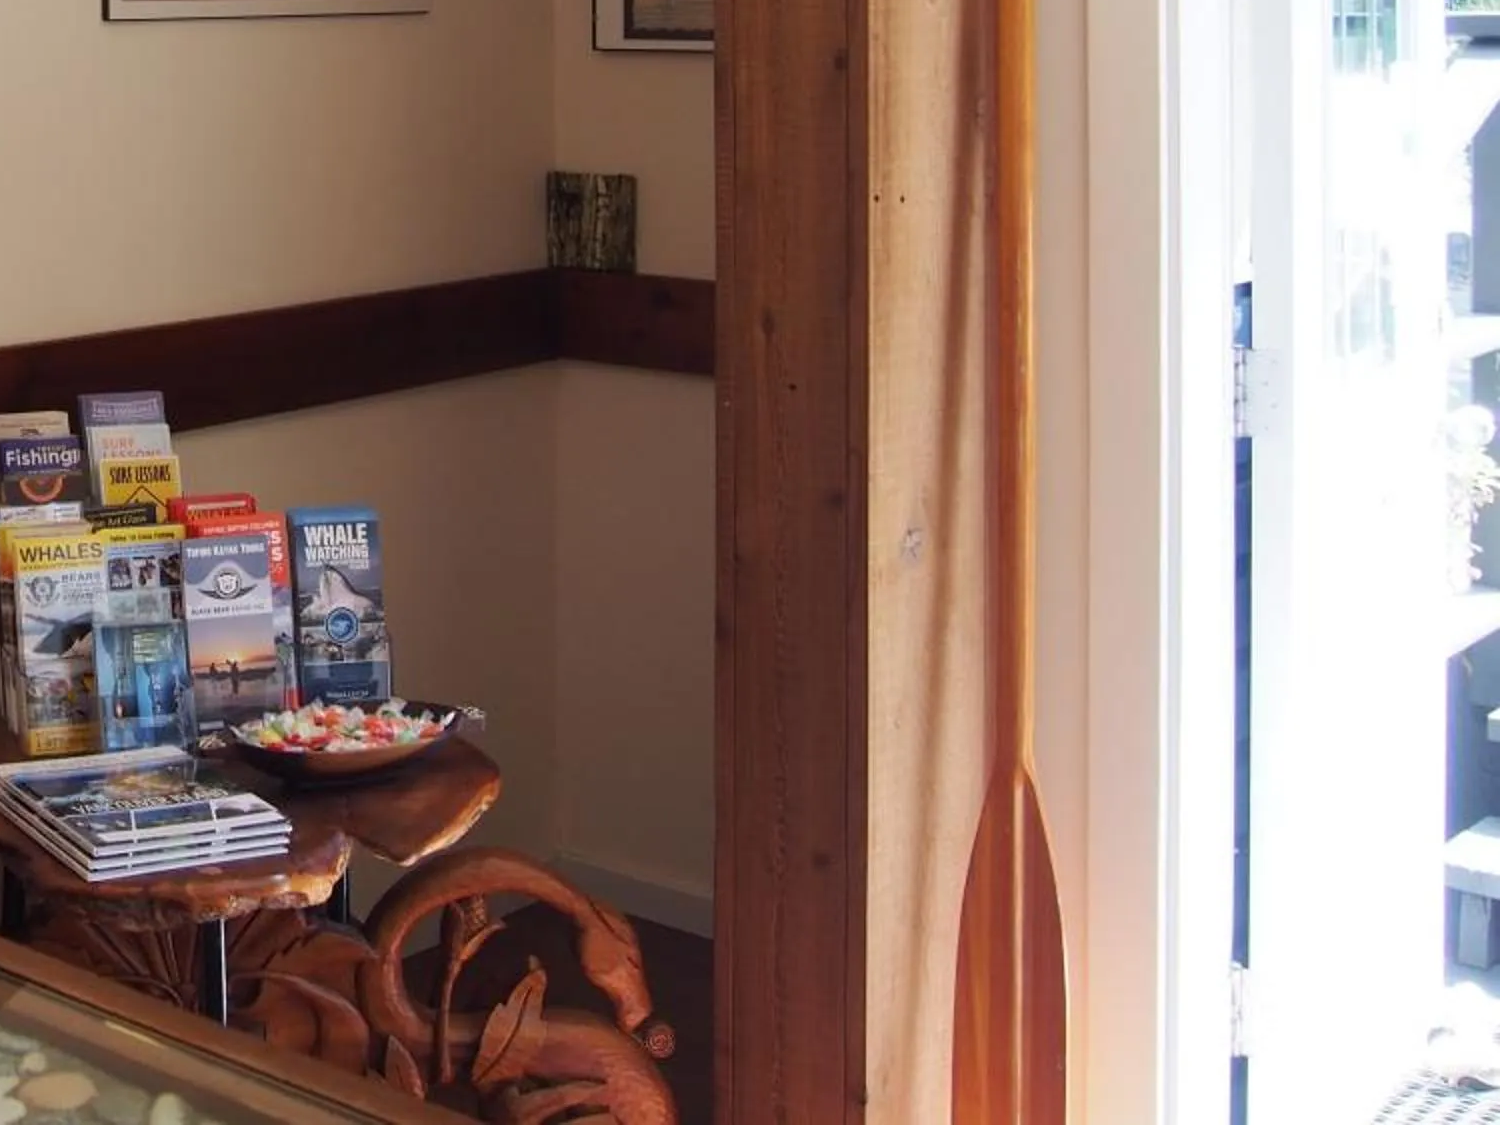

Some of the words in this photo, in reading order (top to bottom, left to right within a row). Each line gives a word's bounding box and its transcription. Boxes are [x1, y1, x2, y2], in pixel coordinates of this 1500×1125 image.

[303, 522, 368, 546] WHALE
[19, 542, 103, 563] WHALES
[304, 544, 369, 561] WATCHING
